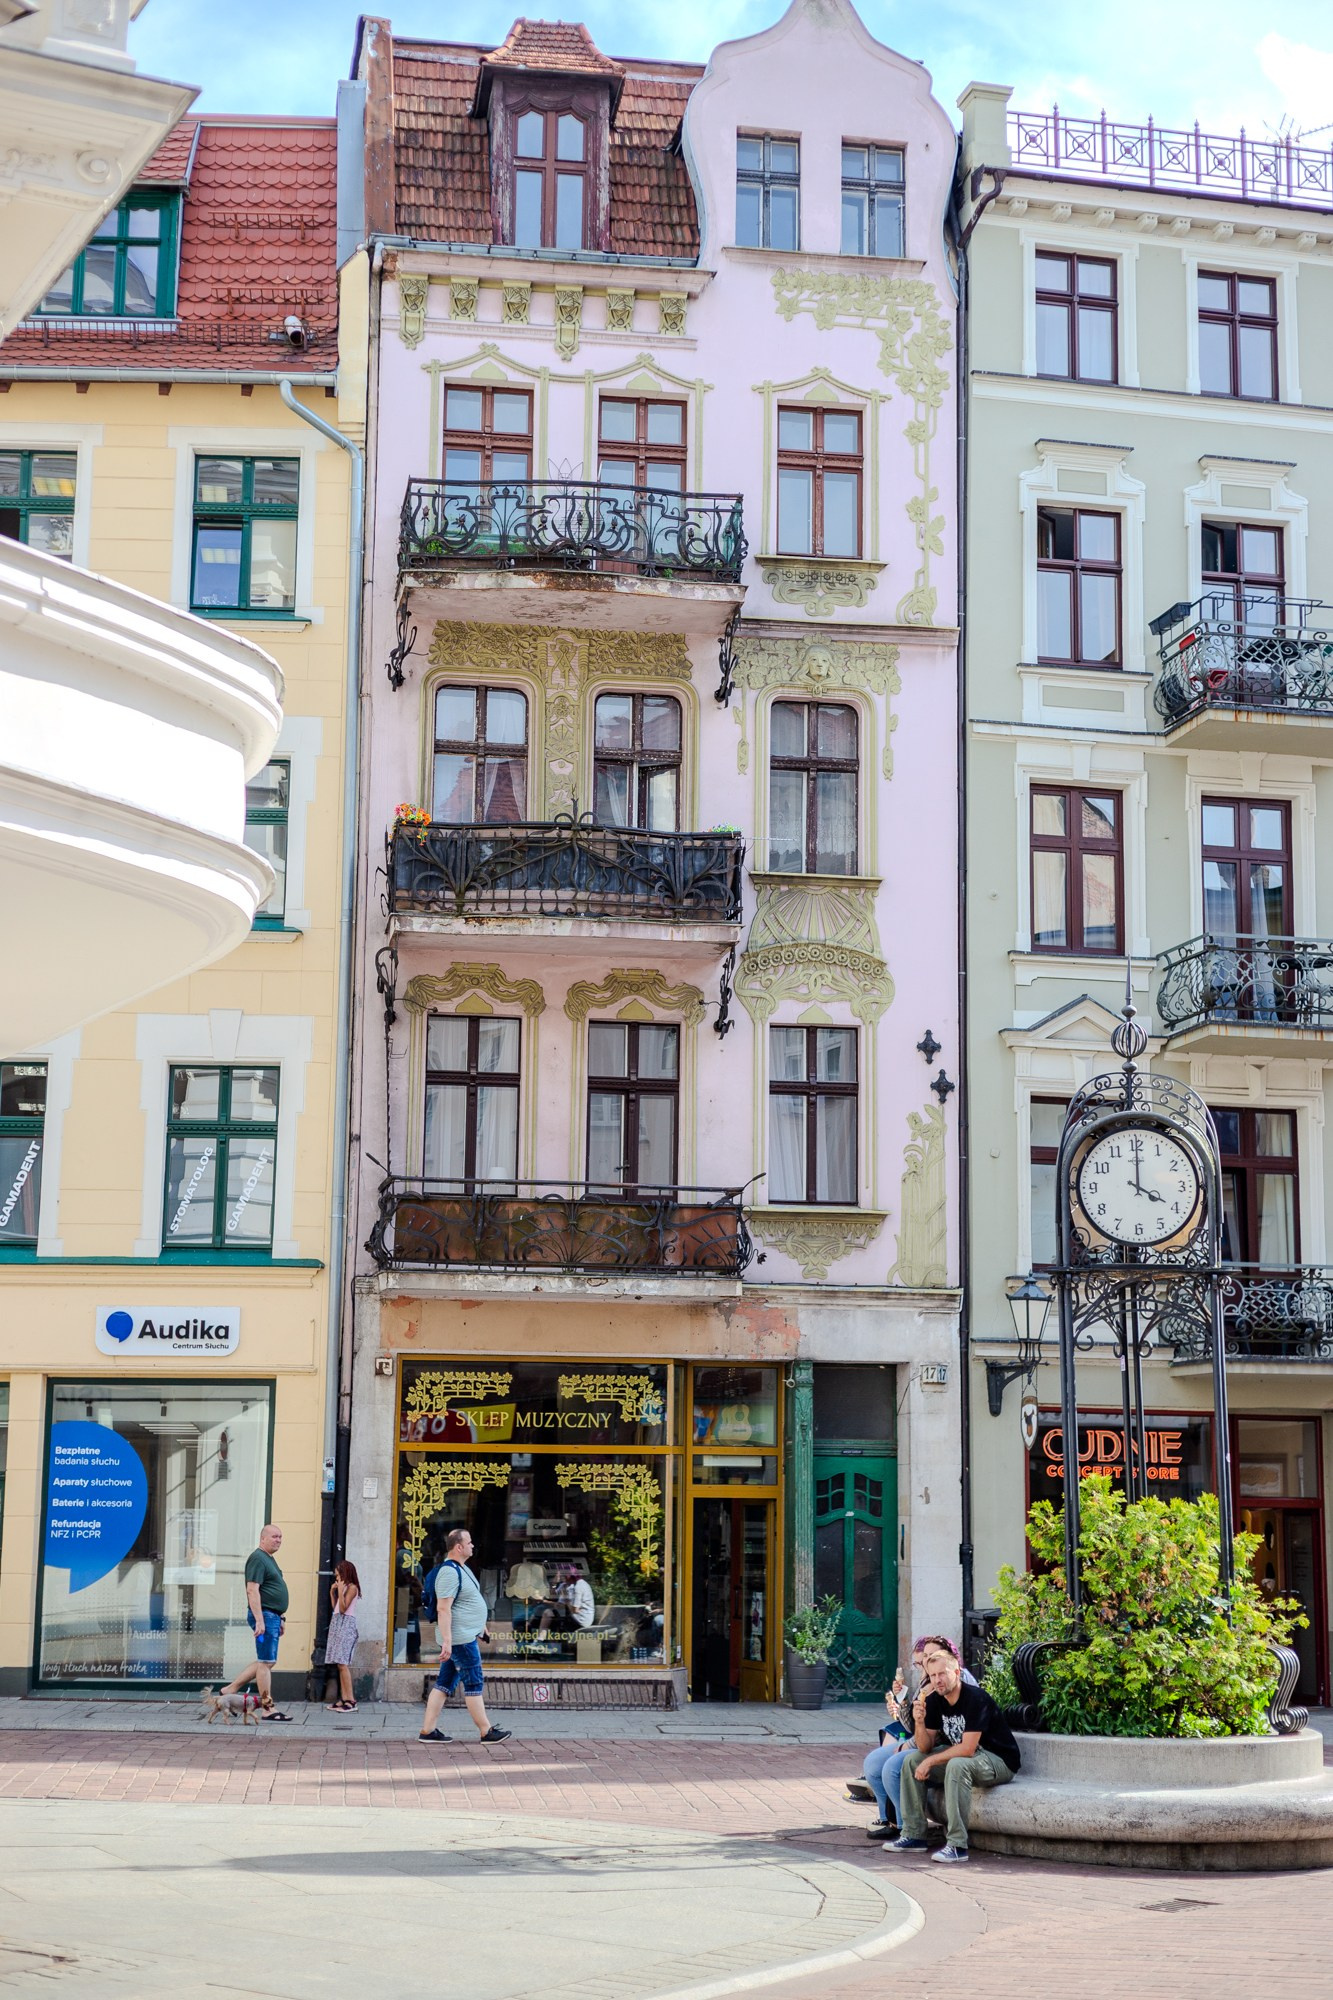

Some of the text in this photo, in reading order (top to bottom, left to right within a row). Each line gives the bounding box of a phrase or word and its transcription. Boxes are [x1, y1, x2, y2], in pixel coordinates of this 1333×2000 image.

[1108, 1145, 1122, 1158] 11
[1129, 1139, 1144, 1152] 12
[1154, 1144, 1162, 1157] 1
[1094, 1161, 1110, 1174] 10
[1169, 1160, 1179, 1172] 2
[0, 1140, 41, 1227] GAMADENT
[169, 1146, 214, 1232] STOMATOLOG
[226, 1147, 272, 1231] GAMADENT
[1088, 1181, 1098, 1194] 9
[1178, 1180, 1186, 1193] 3
[1097, 1202, 1107, 1215] 8
[1170, 1201, 1180, 1214] 4
[1113, 1218, 1123, 1230] 7
[1134, 1222, 1144, 1235] 6
[1156, 1217, 1165, 1230] 5
[138, 1318, 230, 1339] Audika
[923, 1366, 937, 1380] 17
[939, 1368, 947, 1381] 17
[455, 1410, 612, 1428] SKLEP MUZYCZNY
[55, 1446, 100, 1456] Bezpłatne
[54, 1457, 120, 1466] badania słuchu
[1046, 1464, 1123, 1479] COCEPT
[53, 1478, 133, 1487] Aparaty słuchowe
[52, 1498, 85, 1507] Baterie
[91, 1499, 133, 1508] akcesoria
[51, 1519, 101, 1530] Refundacja
[50, 1530, 70, 1539] NFZ
[76, 1530, 102, 1539] PCPR
[132, 1630, 168, 1640] Audika
